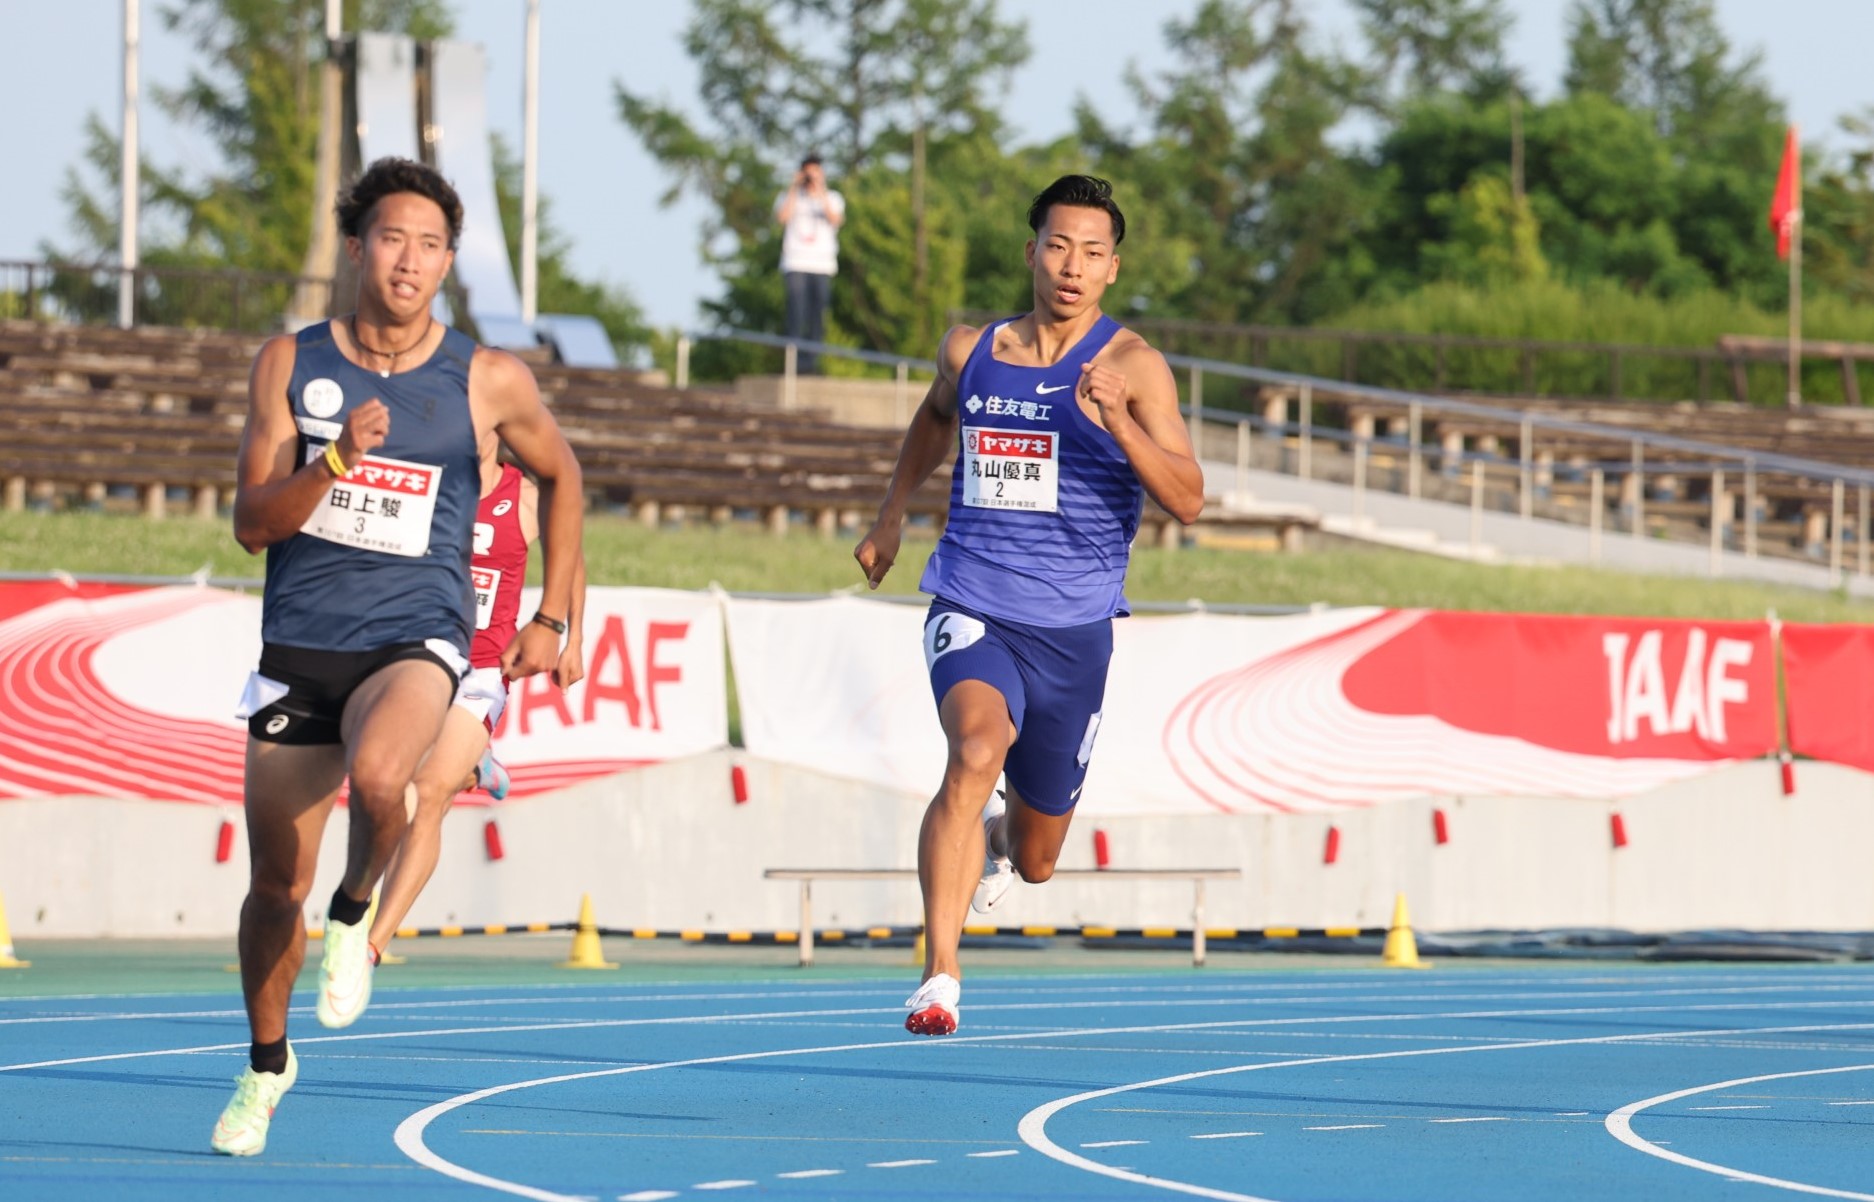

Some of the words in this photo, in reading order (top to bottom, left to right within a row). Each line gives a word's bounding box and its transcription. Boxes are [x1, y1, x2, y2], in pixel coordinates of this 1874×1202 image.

[985, 395, 1052, 421] 住友電工
[981, 435, 1048, 454] ヤマザキ
[971, 459, 1042, 481] 丸山優真
[995, 481, 1004, 498] 2
[330, 488, 402, 519] 田上駿
[354, 516, 366, 534] 3
[933, 614, 952, 654] 6
